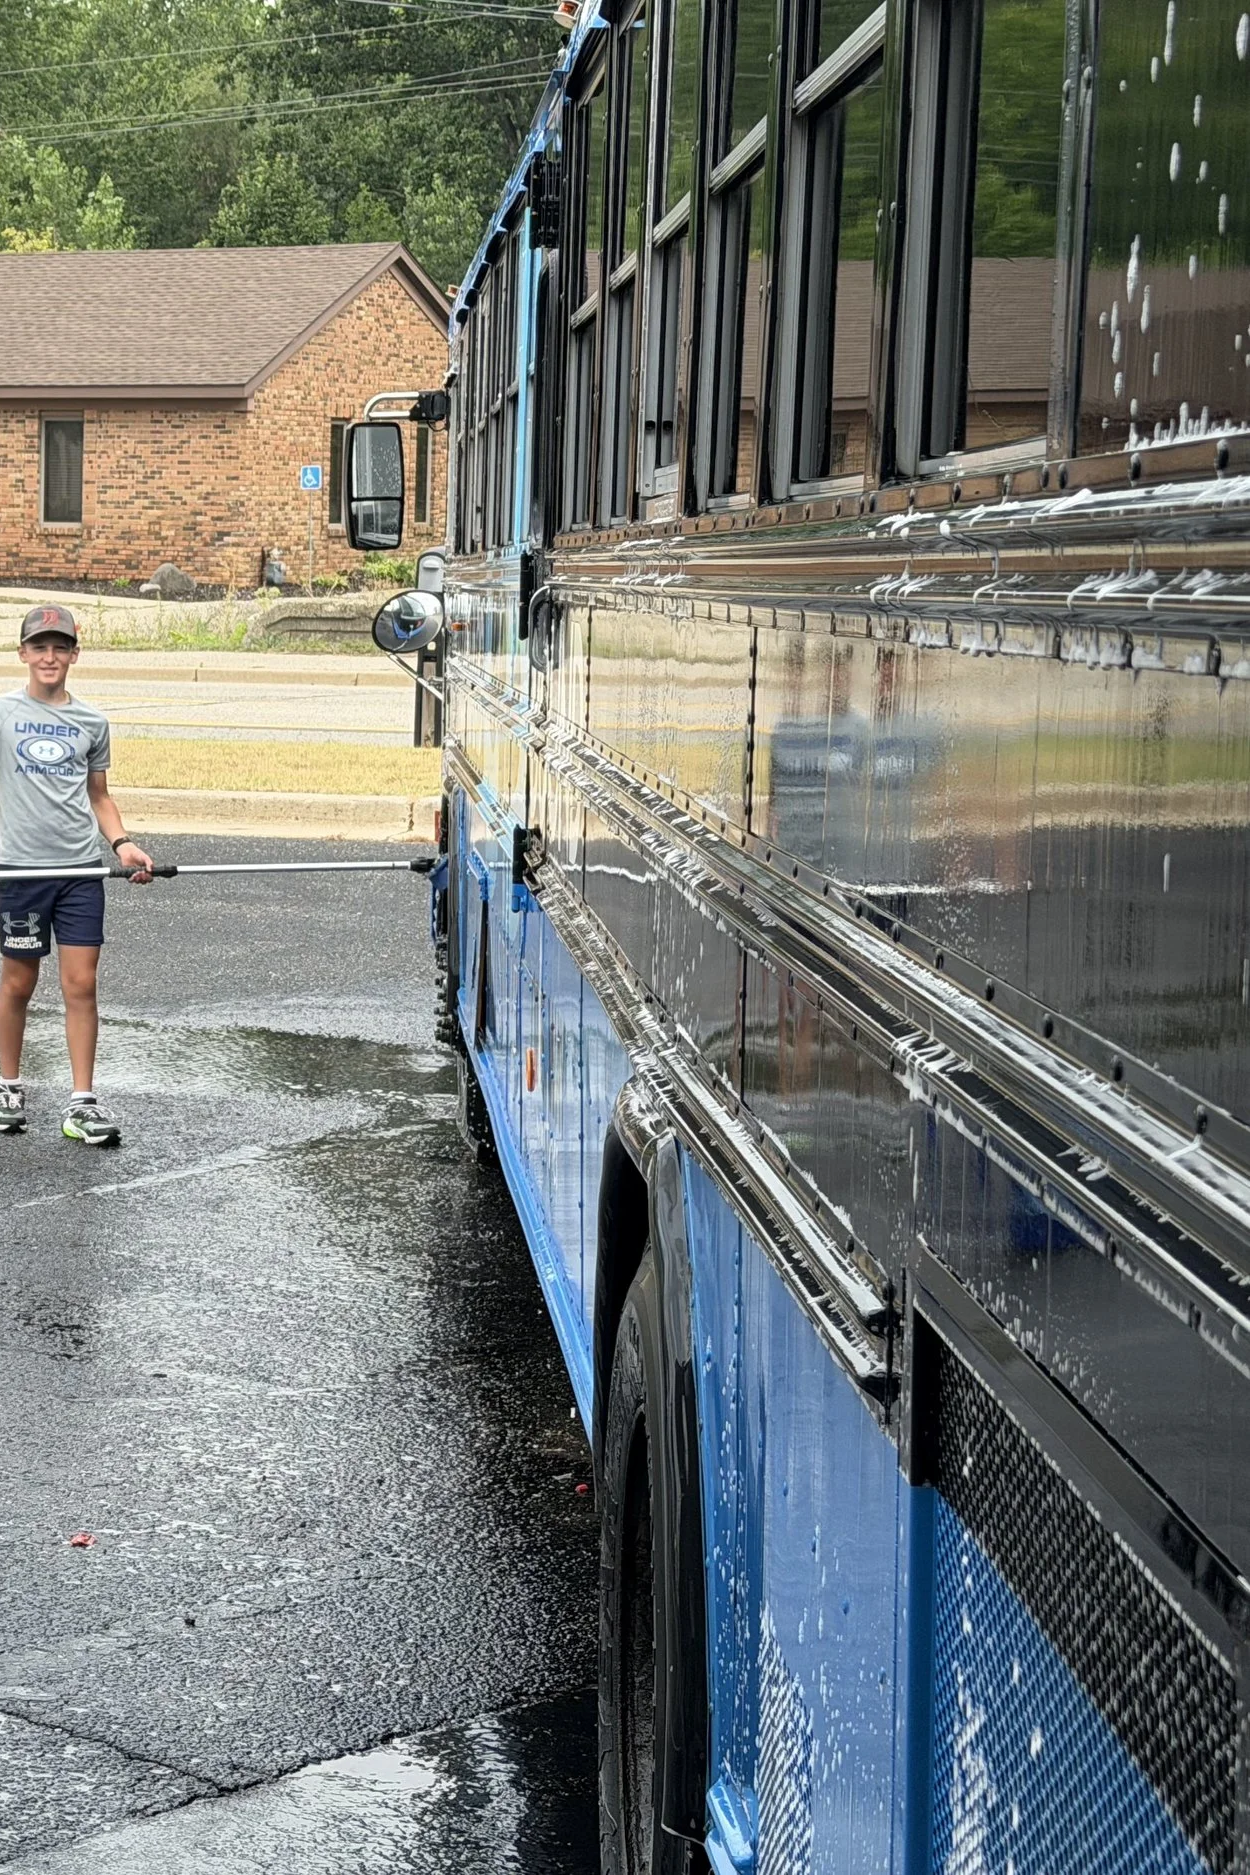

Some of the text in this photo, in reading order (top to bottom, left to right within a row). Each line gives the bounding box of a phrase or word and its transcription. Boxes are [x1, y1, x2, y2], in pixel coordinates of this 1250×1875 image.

[14, 721, 81, 738] UNDER
[14, 764, 75, 777] ARMOUR
[4, 941, 42, 949] ARMOUR
